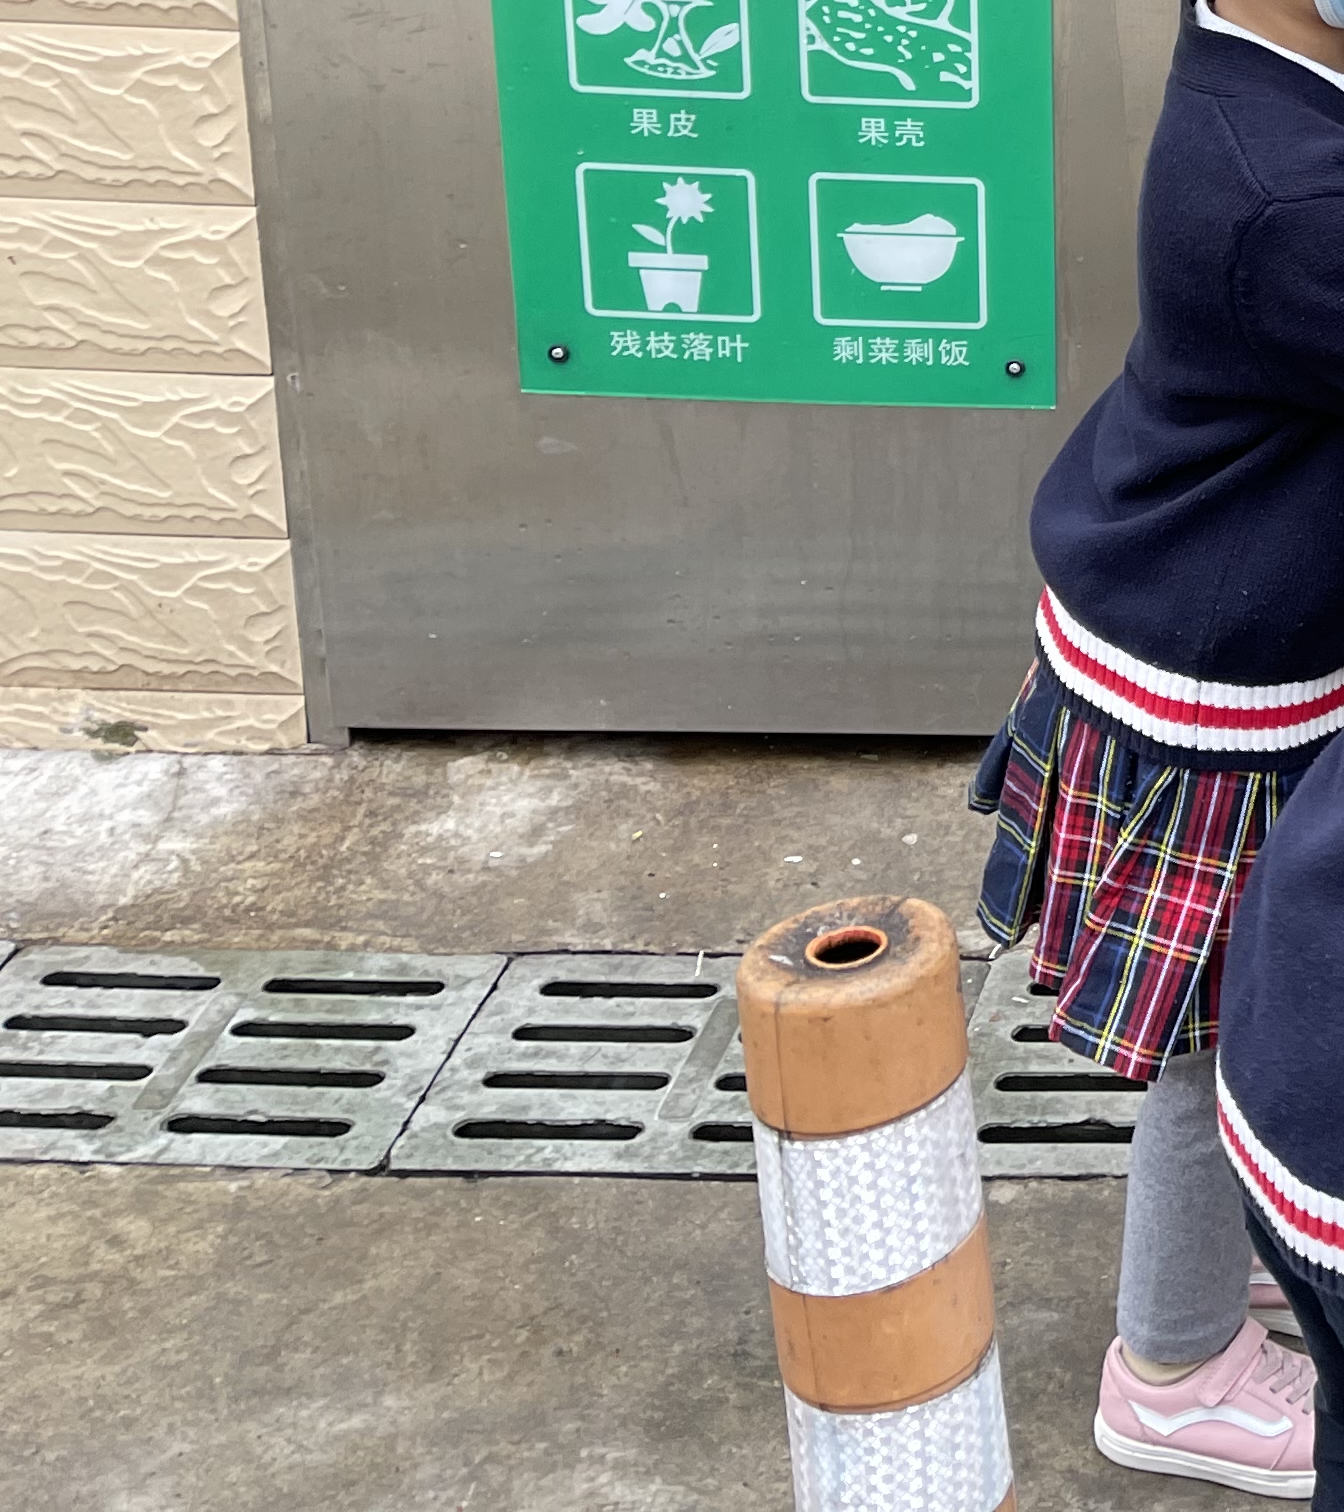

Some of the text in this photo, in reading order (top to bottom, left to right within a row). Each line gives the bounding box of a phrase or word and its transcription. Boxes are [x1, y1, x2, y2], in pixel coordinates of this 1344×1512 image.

[630, 108, 698, 138] 果皮
[858, 117, 925, 147] 果壳
[610, 329, 749, 363] 残枝落叶
[833, 336, 970, 366] 剩菜剩饭
